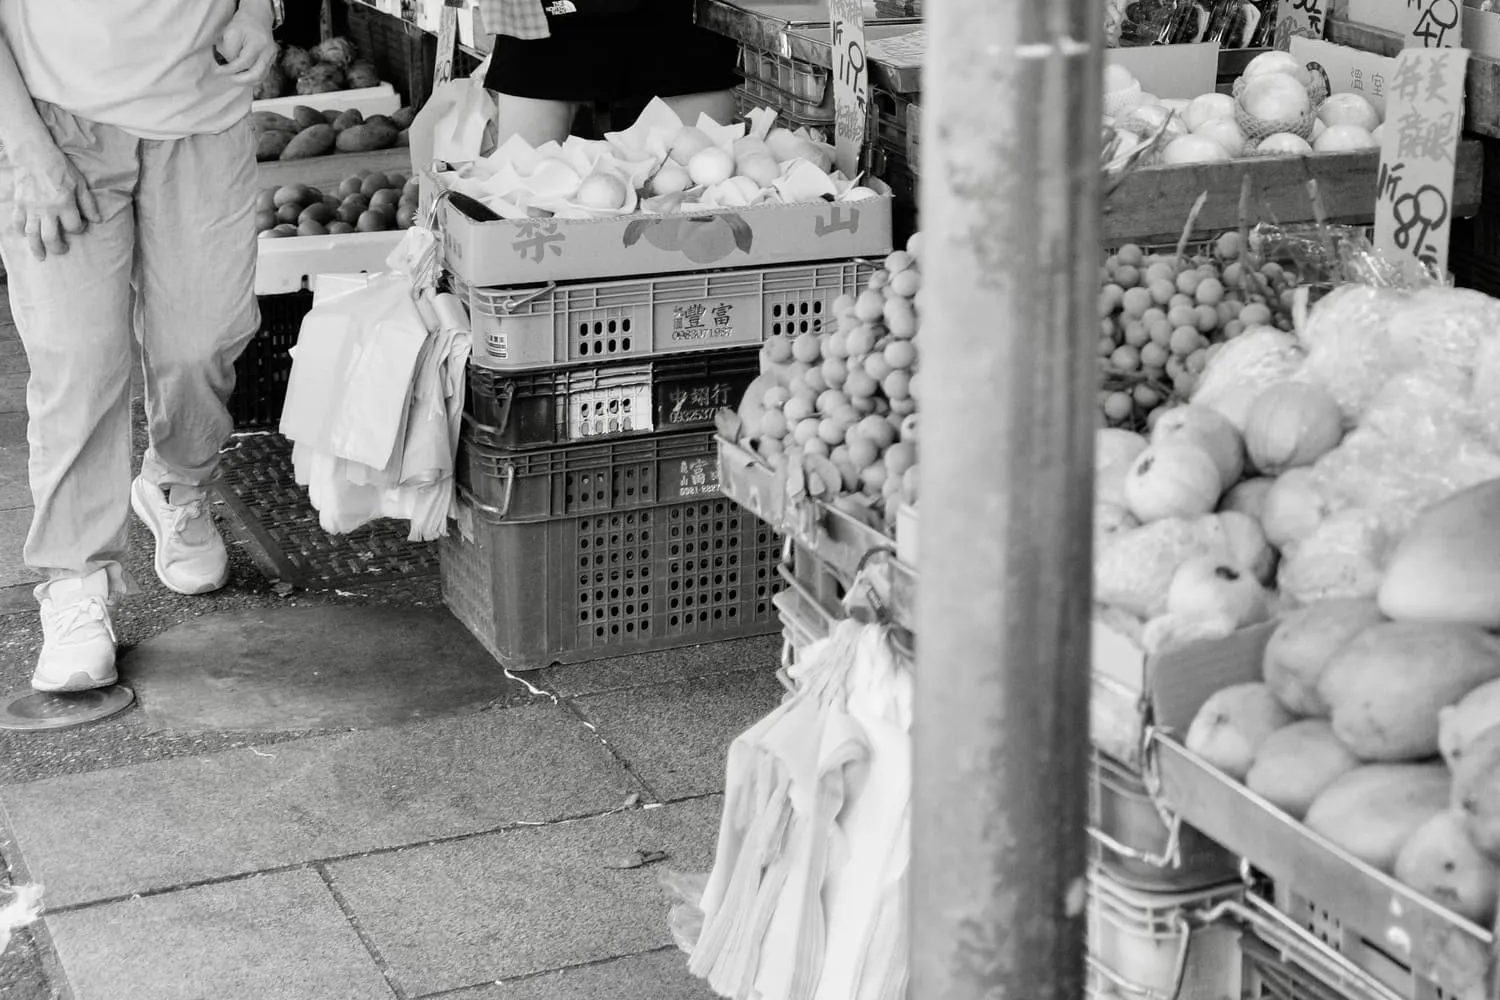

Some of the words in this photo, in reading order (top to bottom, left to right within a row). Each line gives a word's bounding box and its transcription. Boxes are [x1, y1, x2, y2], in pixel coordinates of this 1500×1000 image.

[512, 219, 567, 264] 梨
[814, 206, 860, 237] 山
[1393, 184, 1448, 257] 89
